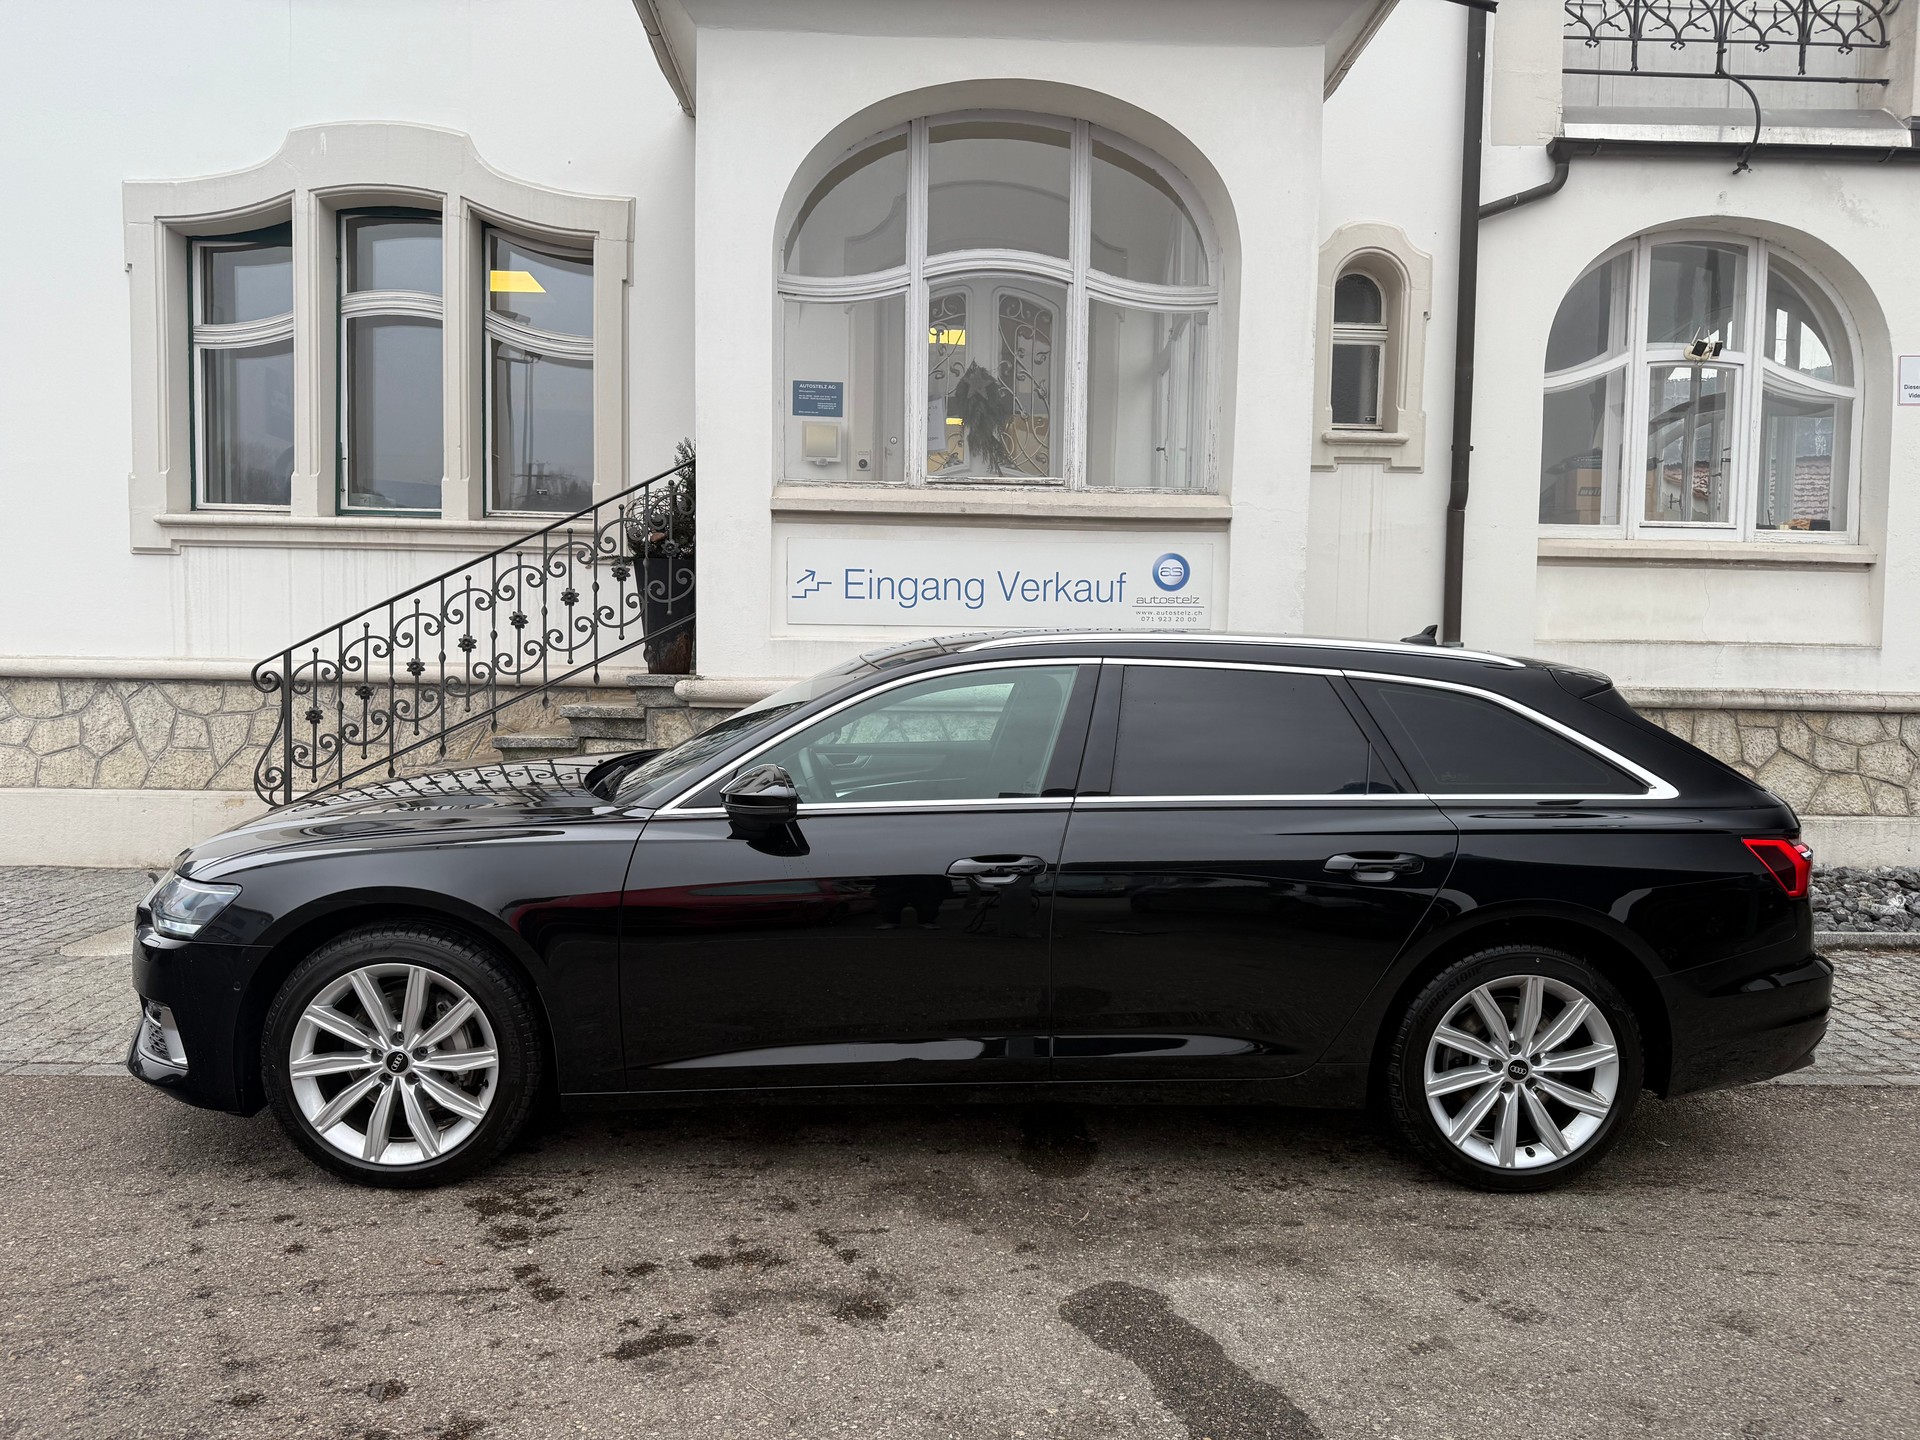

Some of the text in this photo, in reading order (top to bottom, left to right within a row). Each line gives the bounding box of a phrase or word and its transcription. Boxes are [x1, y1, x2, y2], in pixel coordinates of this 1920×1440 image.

[844, 568, 1127, 610] Eingang Verkauf
[1136, 594, 1200, 605] autostelz
